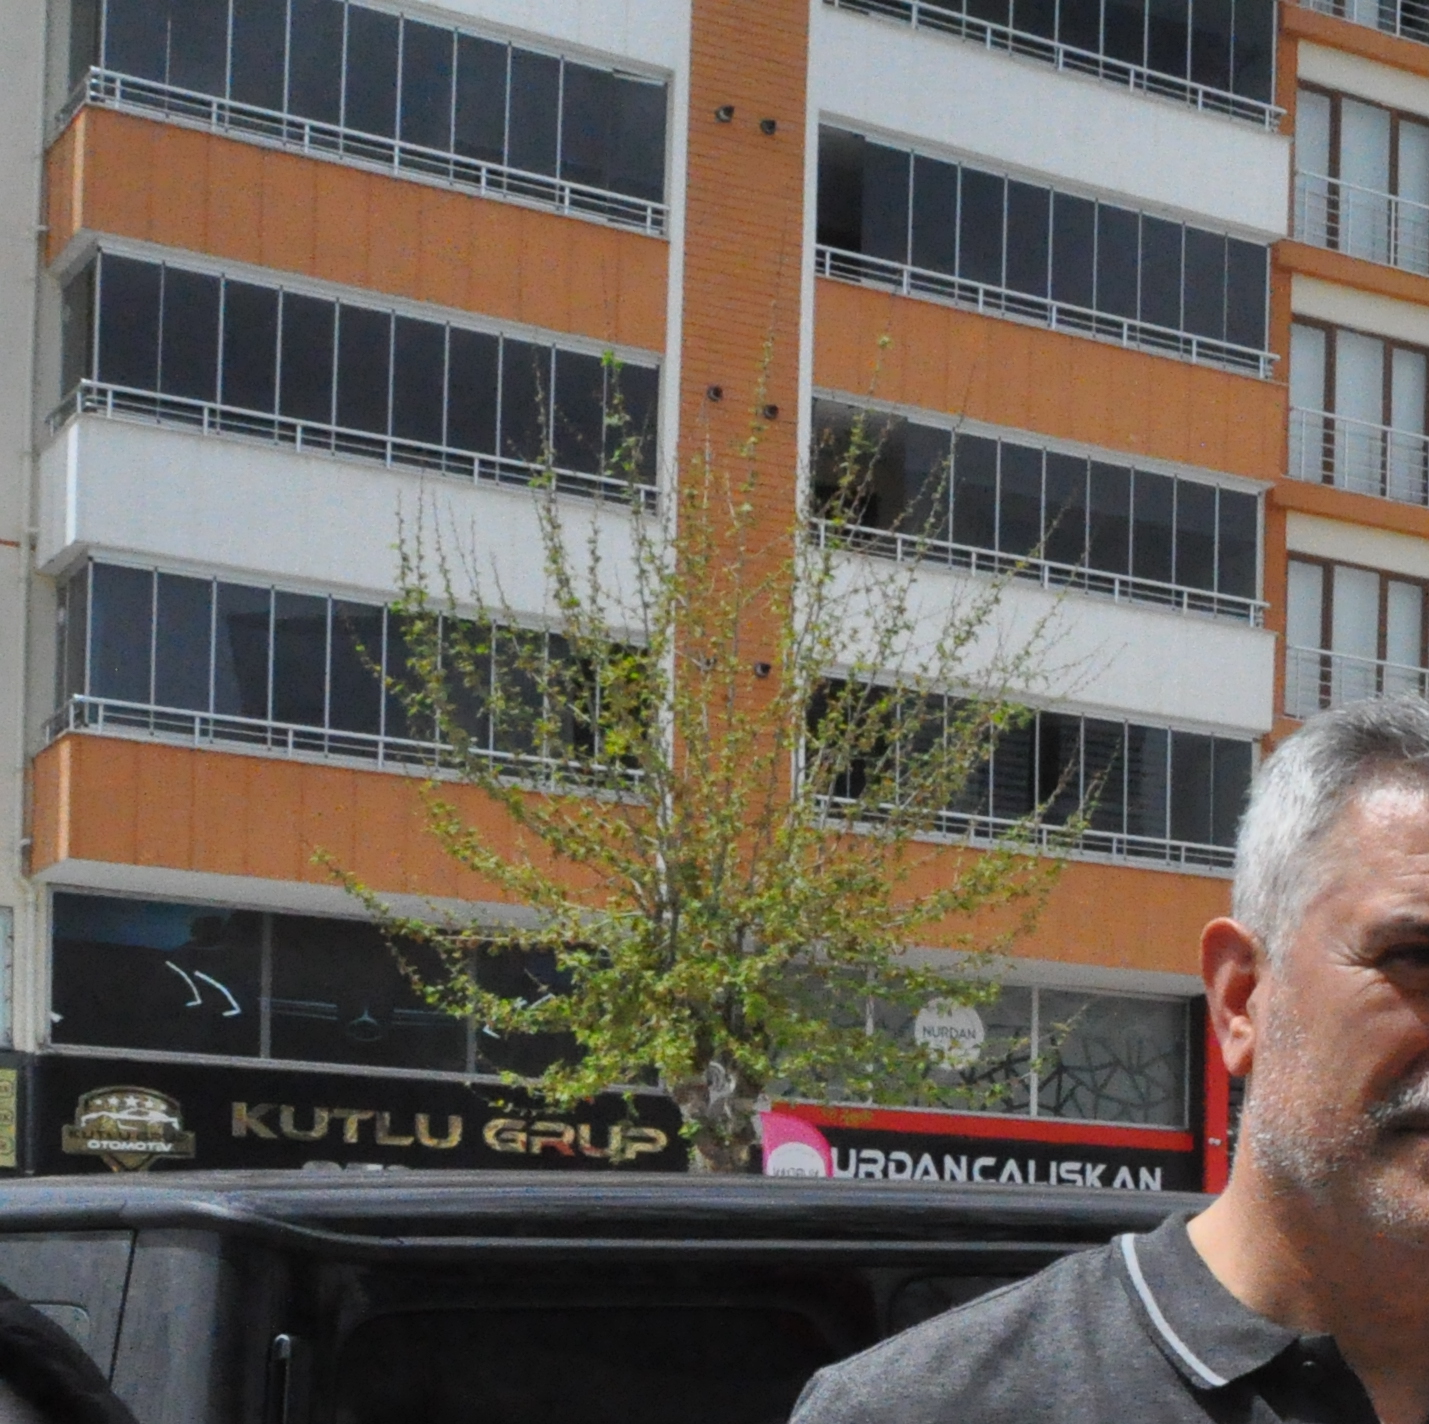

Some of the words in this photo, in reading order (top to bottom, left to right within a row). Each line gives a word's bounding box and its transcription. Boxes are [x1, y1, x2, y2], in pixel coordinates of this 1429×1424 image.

[922, 1025, 976, 1040] NURDAN
[231, 1101, 462, 1149] KUTLU
[483, 1118, 668, 1164] GRUP
